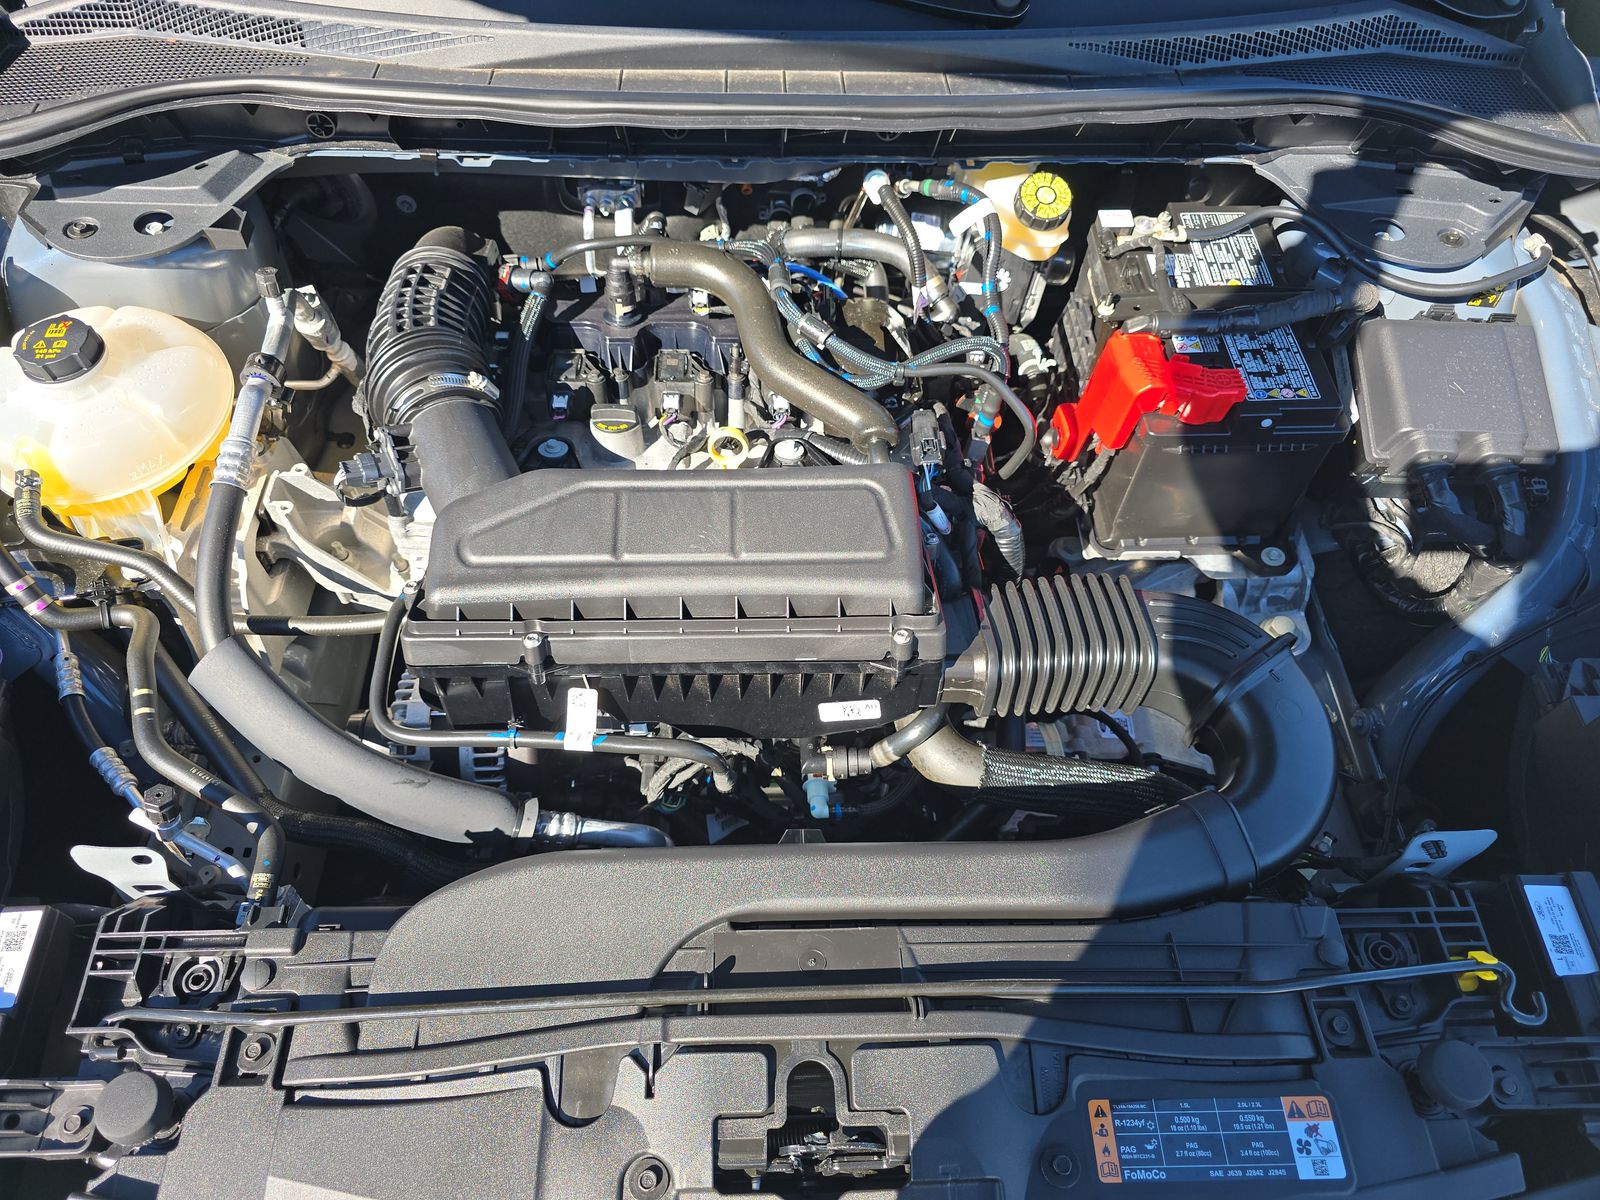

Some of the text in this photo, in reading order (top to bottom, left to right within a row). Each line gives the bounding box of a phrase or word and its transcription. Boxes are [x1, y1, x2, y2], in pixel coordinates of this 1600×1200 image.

[1191, 1116, 1200, 1124] kg
[1256, 1114, 1265, 1123] kg
[1114, 1119, 1146, 1128] R-1234yf
[1124, 1170, 1166, 1180] FoMoCo
